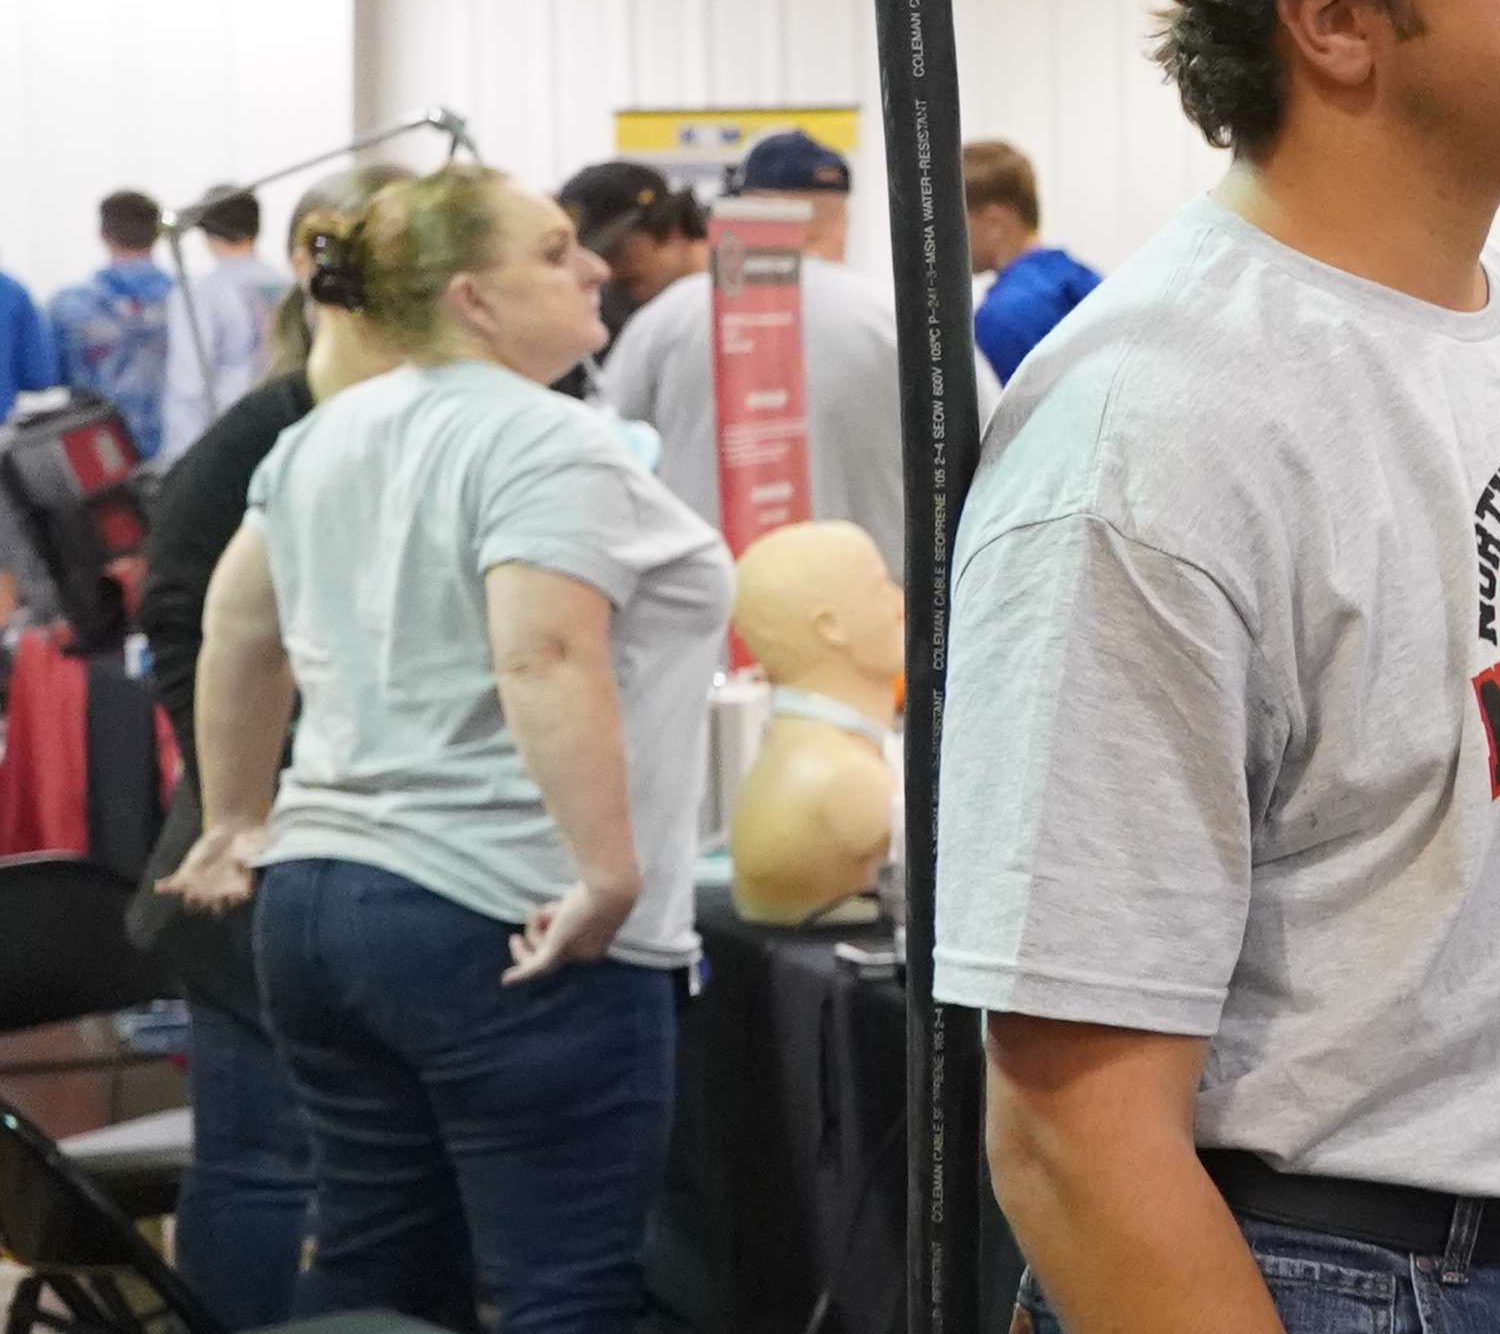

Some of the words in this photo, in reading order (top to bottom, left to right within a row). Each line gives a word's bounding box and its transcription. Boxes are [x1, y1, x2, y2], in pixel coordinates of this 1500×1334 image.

[910, 13, 926, 78] COLEMAN
[915, 99, 935, 221] WATER-RESISTANT
[930, 367, 944, 396] 600V
[931, 400, 946, 439] SEOW
[934, 469, 947, 489] 105
[933, 493, 947, 561] SEOPRENE
[933, 566, 947, 606] CABLE
[931, 610, 946, 670] COLEMAN
[932, 1055, 944, 1120] SEPRENE
[931, 1123, 945, 1161] CABLE
[931, 1164, 945, 1224] COLEMAN
